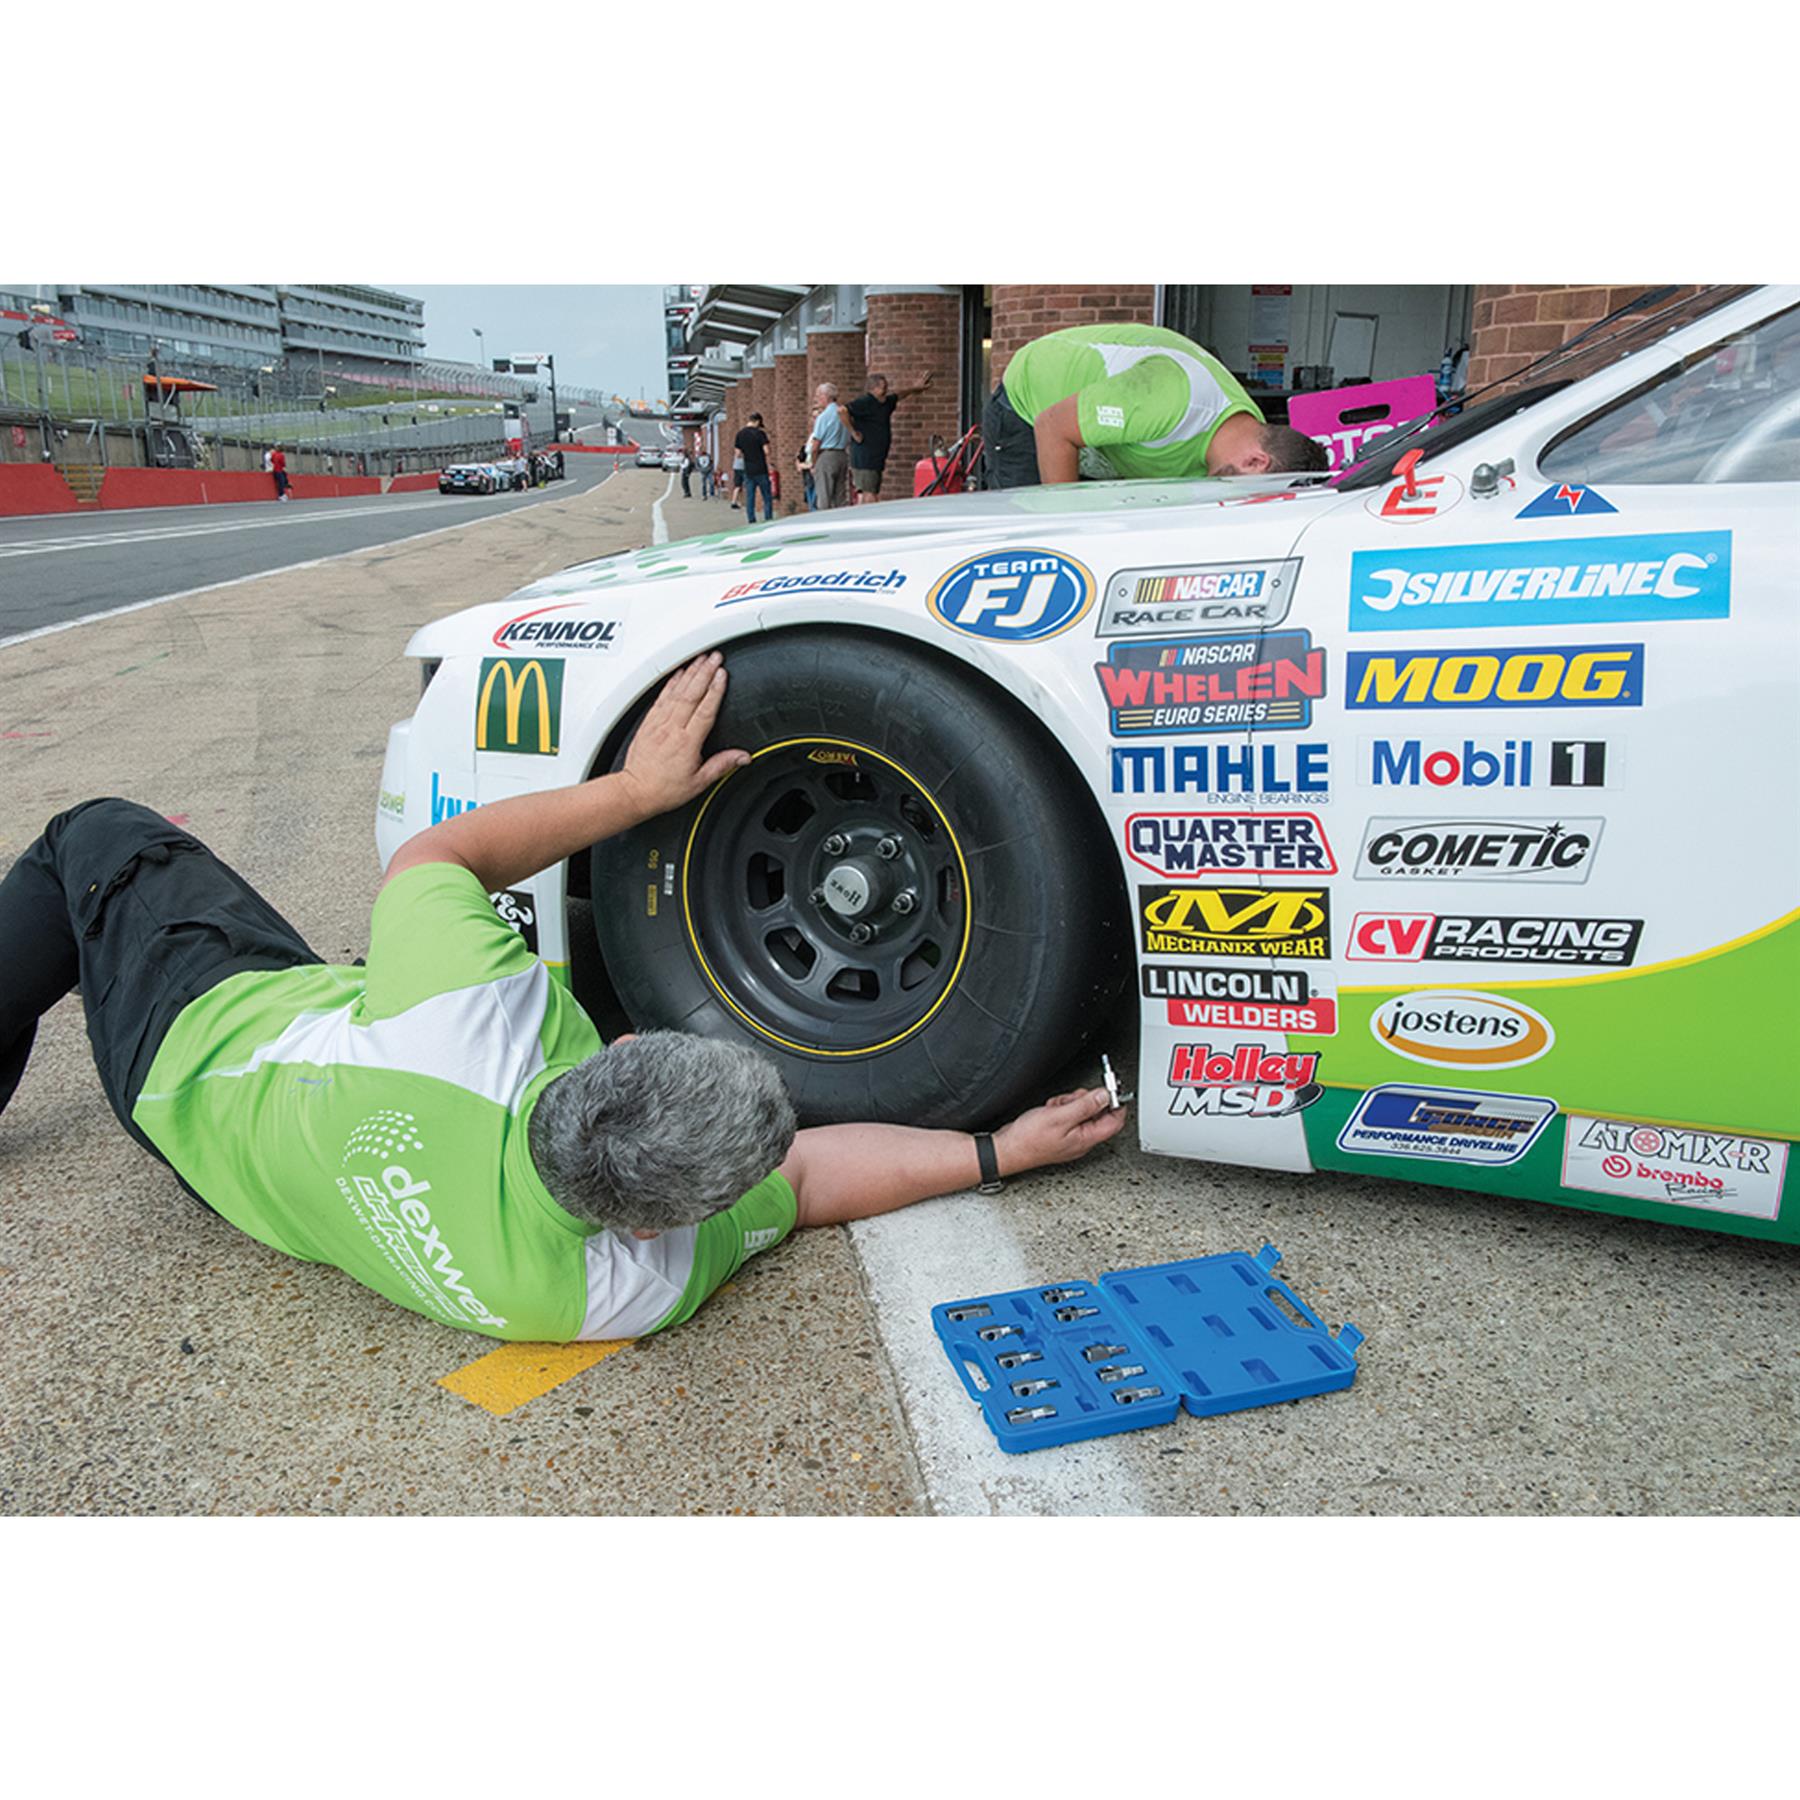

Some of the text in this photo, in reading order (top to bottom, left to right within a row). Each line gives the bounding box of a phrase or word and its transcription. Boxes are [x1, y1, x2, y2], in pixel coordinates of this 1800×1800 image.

[973, 558, 1058, 576] TEAM
[720, 569, 907, 601] BFGoodrich
[1173, 572, 1262, 601] NASCAR
[954, 573, 1058, 628] FJ
[1112, 605, 1267, 626] RACE CAR
[501, 621, 616, 642] KENNOL
[535, 642, 593, 650] PERFORMANCE
[1182, 644, 1256, 666] NASCAR
[1099, 651, 1323, 707] WHELEN
[1355, 652, 1633, 703] MOOG
[1154, 704, 1268, 726] EURO SERIES
[1111, 744, 1329, 793] MAHLE
[1371, 740, 1533, 787] Mobil
[1207, 792, 1329, 804] ENGINE BEARINGS
[1132, 819, 1315, 855] QUARTER
[1368, 832, 1591, 868] COMETIC
[1165, 844, 1327, 870] MASTER
[1380, 868, 1463, 876] GASKET
[1146, 930, 1327, 957] MECHANIX WEAR
[1357, 919, 1427, 955] CV
[1434, 919, 1634, 947] RACING
[1433, 946, 1626, 962] PRODUCTS
[1150, 969, 1300, 1001] LINCOLN
[1183, 1003, 1318, 1030] WELDERS
[1387, 1001, 1521, 1039] jostens
[1169, 1045, 1320, 1090] Holley
[1169, 1085, 1298, 1116] MSD
[1352, 1128, 1519, 1154] PERFORMANCE DRIVELINE
[1636, 1163, 1724, 1190] brembo
[381, 1165, 509, 1328] dexwet
